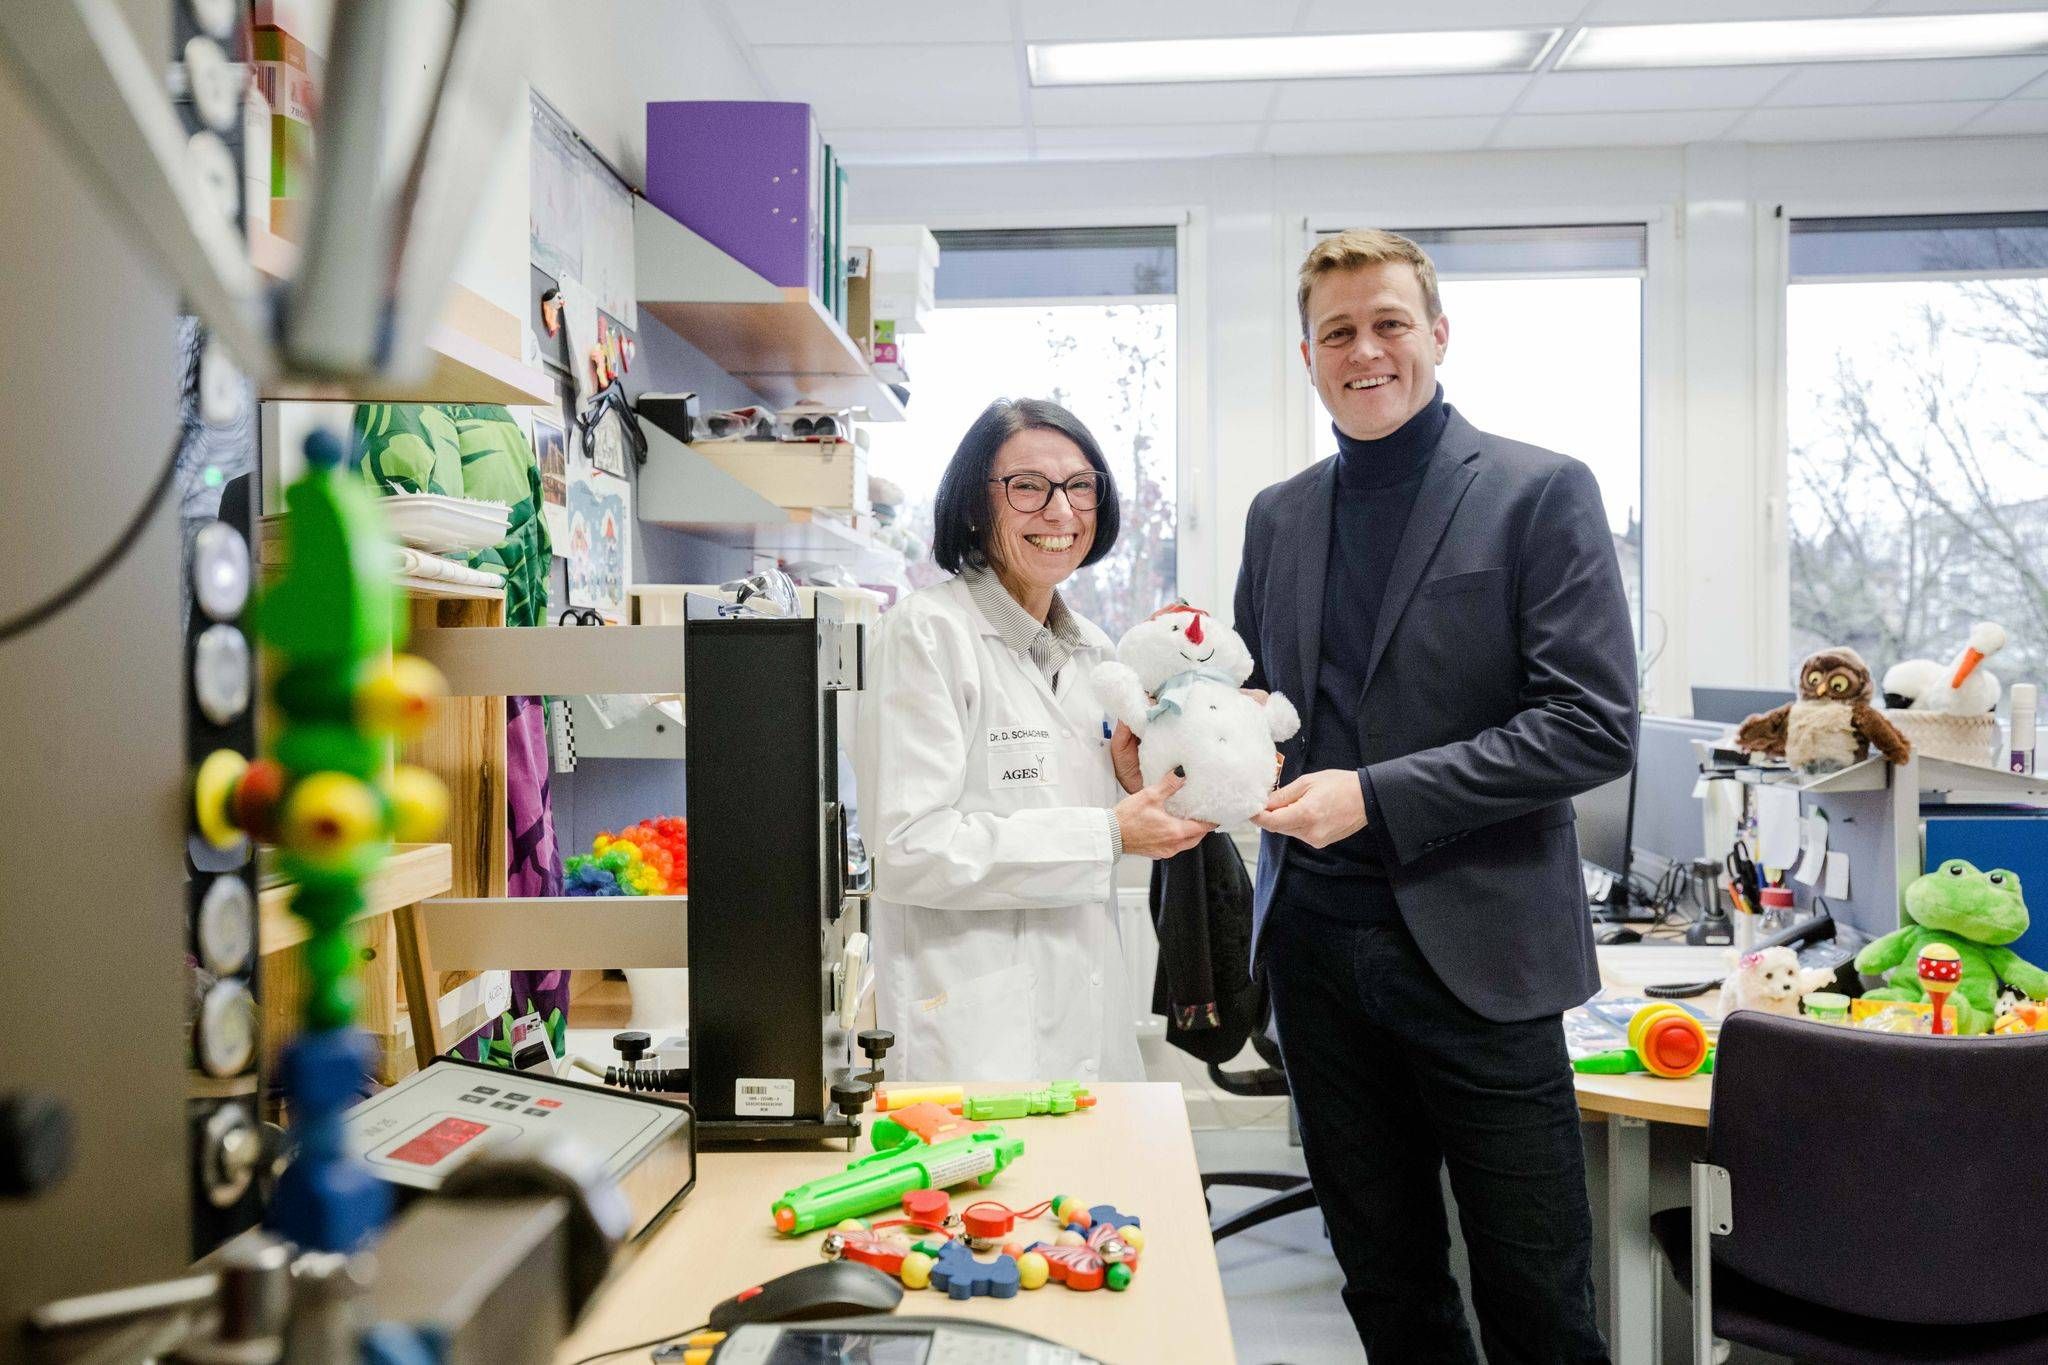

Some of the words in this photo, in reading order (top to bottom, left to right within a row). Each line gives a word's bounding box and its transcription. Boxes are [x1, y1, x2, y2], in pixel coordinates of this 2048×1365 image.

[990, 733, 1001, 742] Dr.
[1002, 732, 1010, 740] D.
[1002, 768, 1039, 780] AGES
